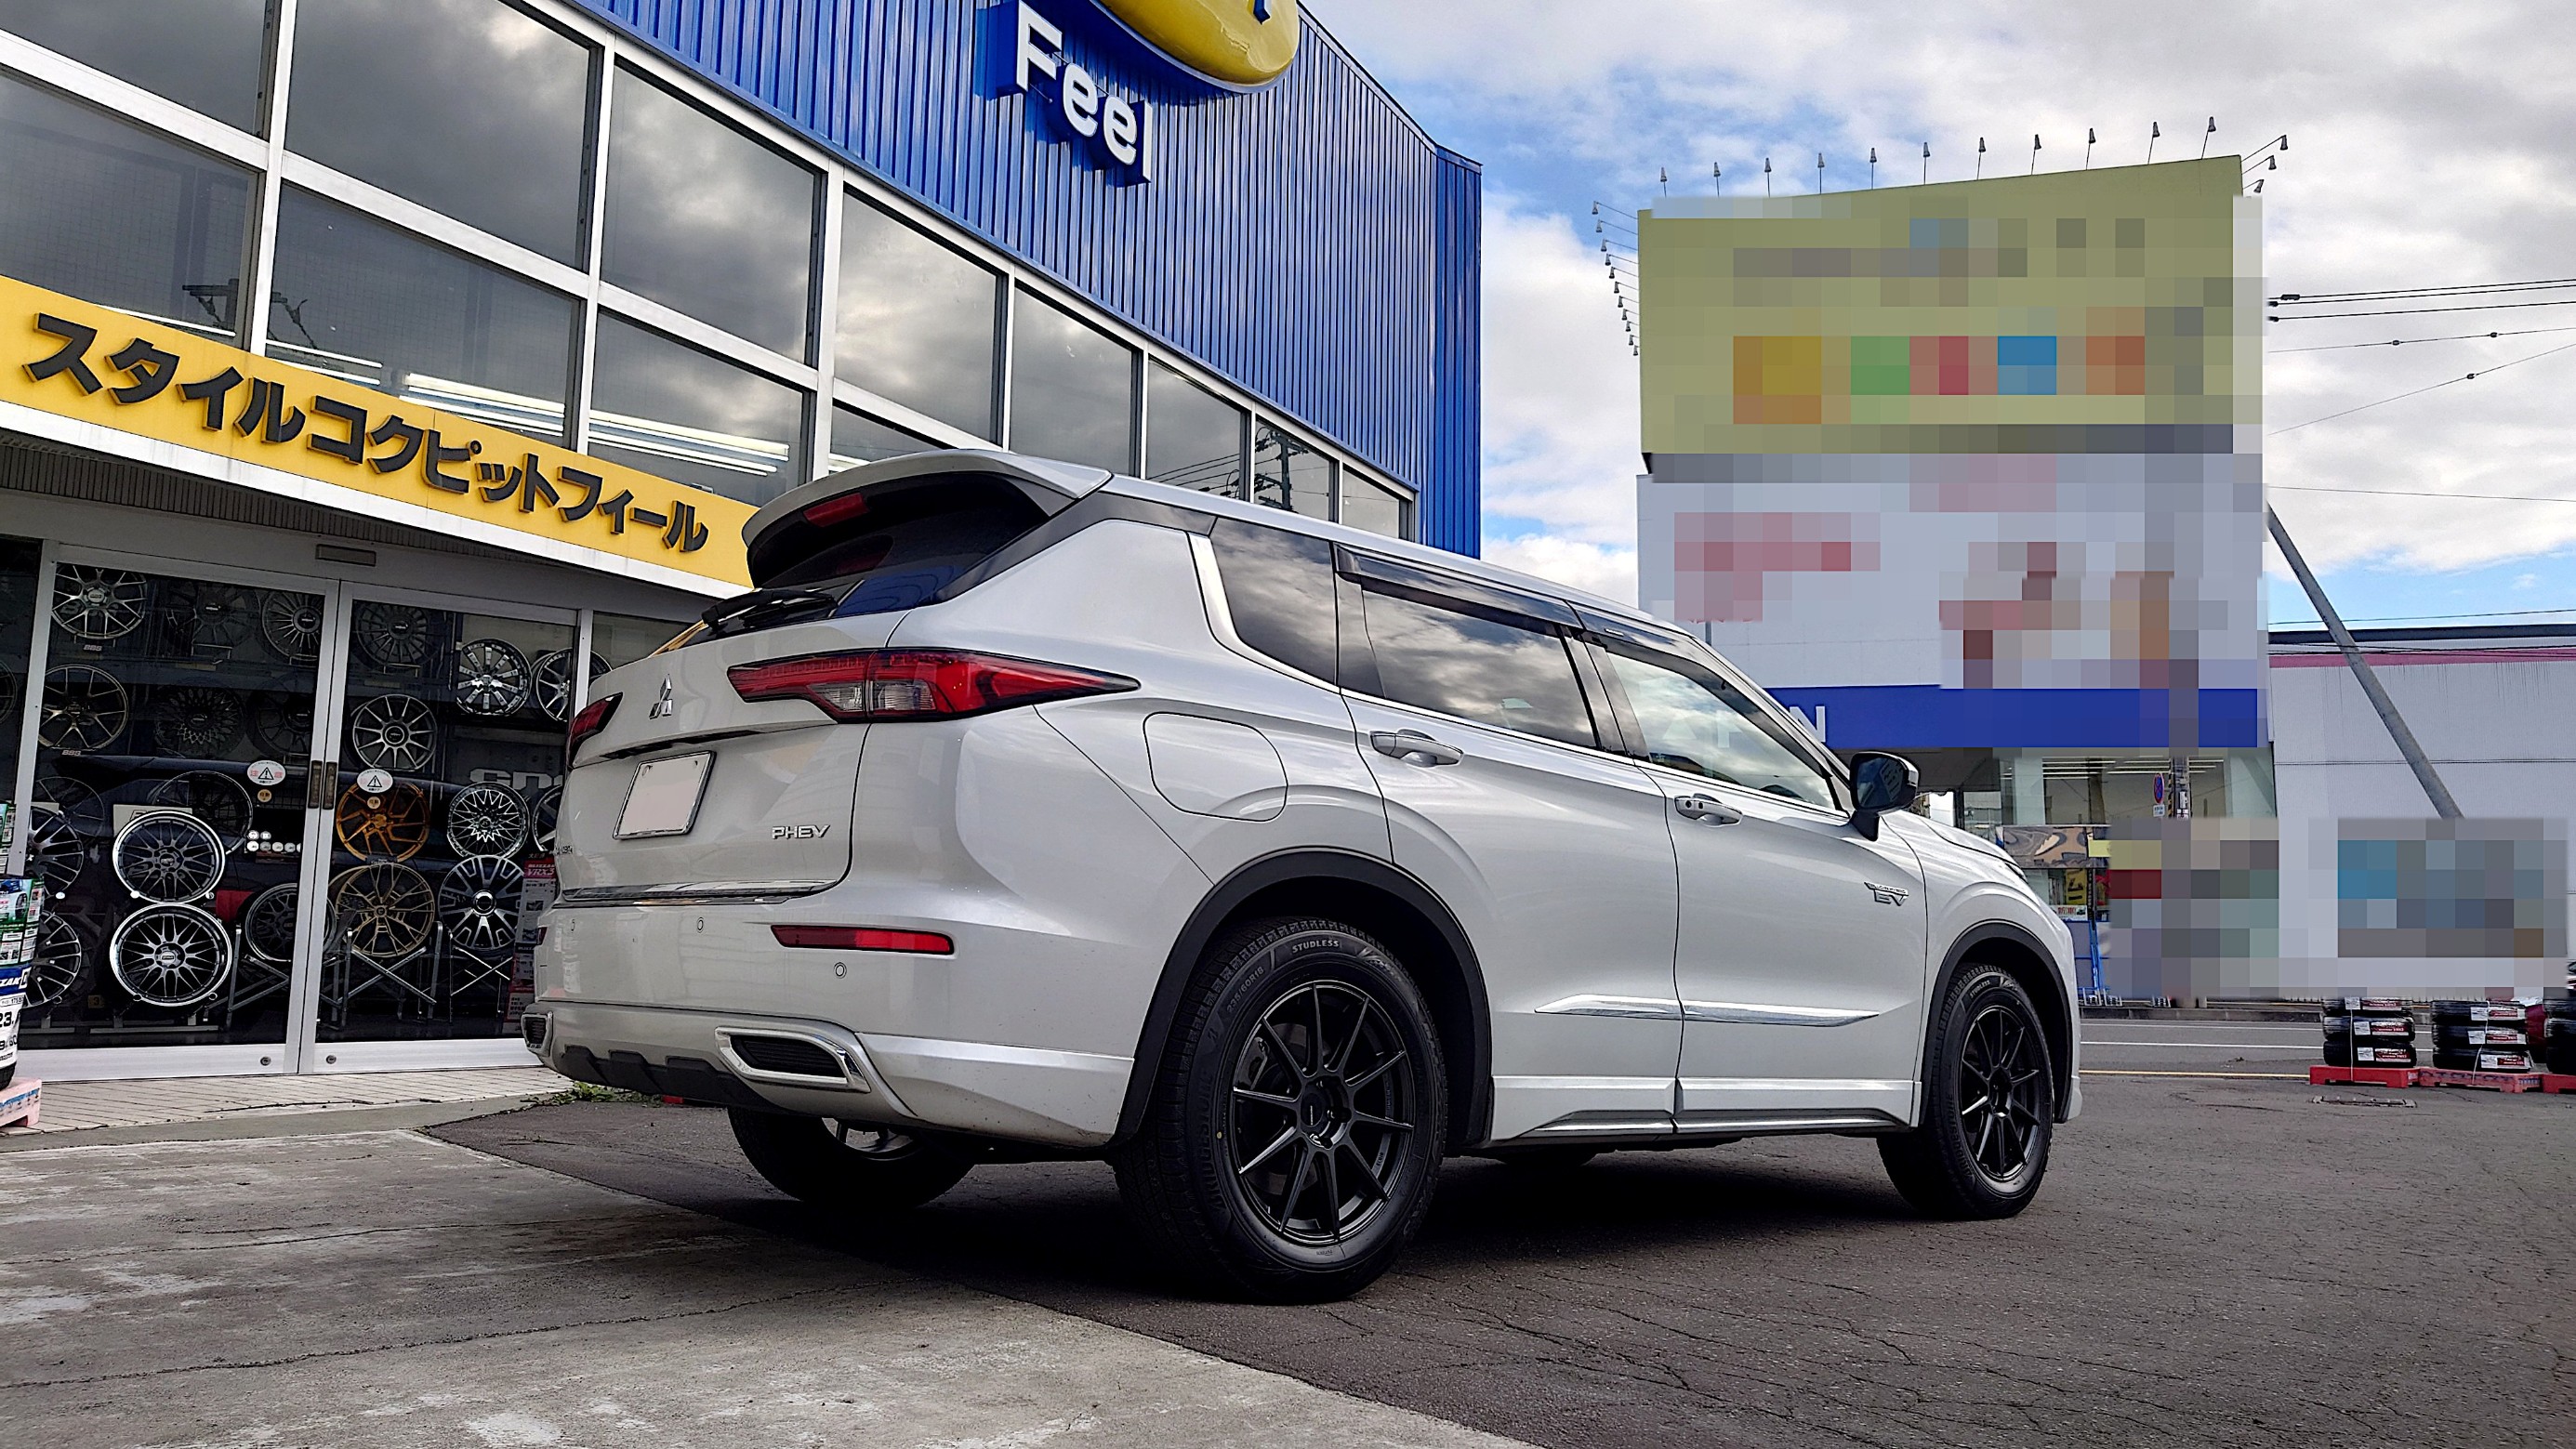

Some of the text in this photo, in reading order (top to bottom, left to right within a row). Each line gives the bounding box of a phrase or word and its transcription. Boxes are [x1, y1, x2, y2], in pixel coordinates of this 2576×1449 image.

[1016, 0, 1153, 183] Feel
[22, 311, 709, 553] スタイルコクピットフィール
[772, 823, 830, 839] PHEV
[527, 867, 555, 876] VRX3
[1291, 939, 1341, 955] STUDLESS
[1226, 965, 1265, 1014] 235/60R18
